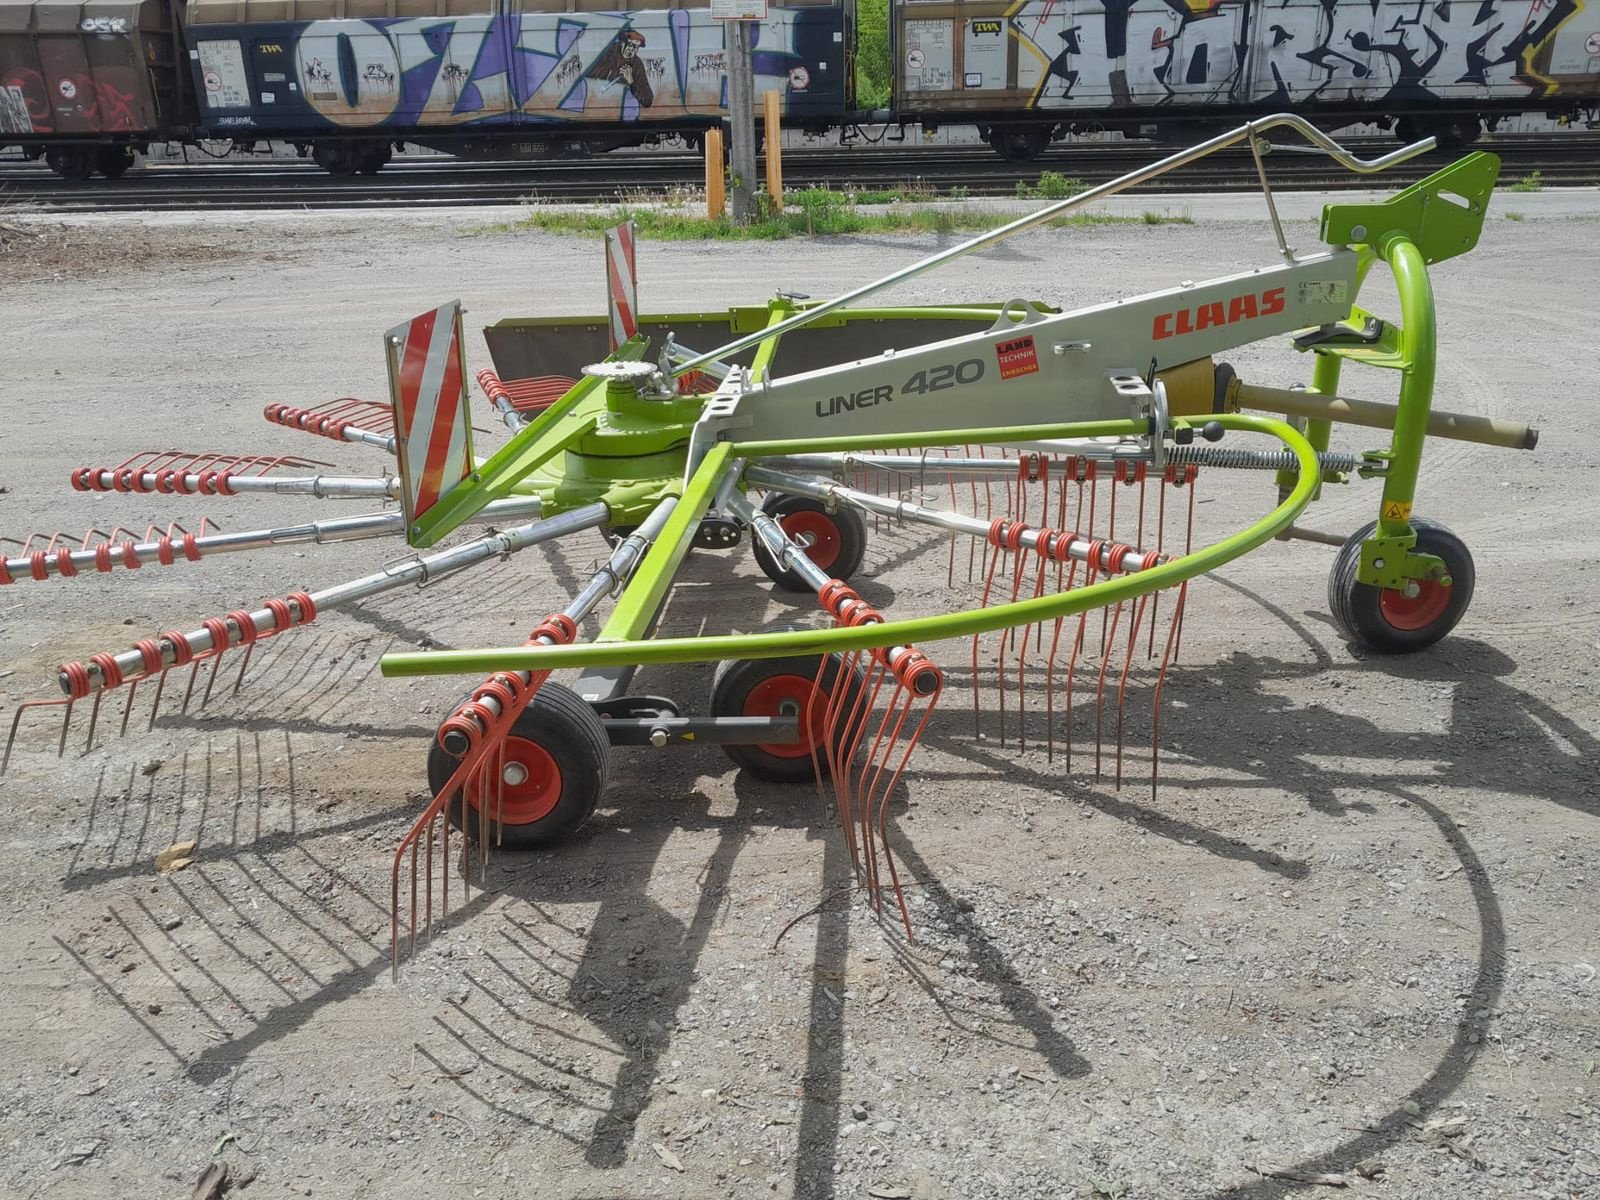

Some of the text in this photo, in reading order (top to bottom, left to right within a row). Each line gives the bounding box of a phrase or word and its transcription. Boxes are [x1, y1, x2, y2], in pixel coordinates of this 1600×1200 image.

[1152, 287, 1286, 340] CLAAS
[996, 338, 1033, 355] LAND
[1000, 349, 1035, 363] TECHNIK
[815, 358, 986, 418] LINER 420
